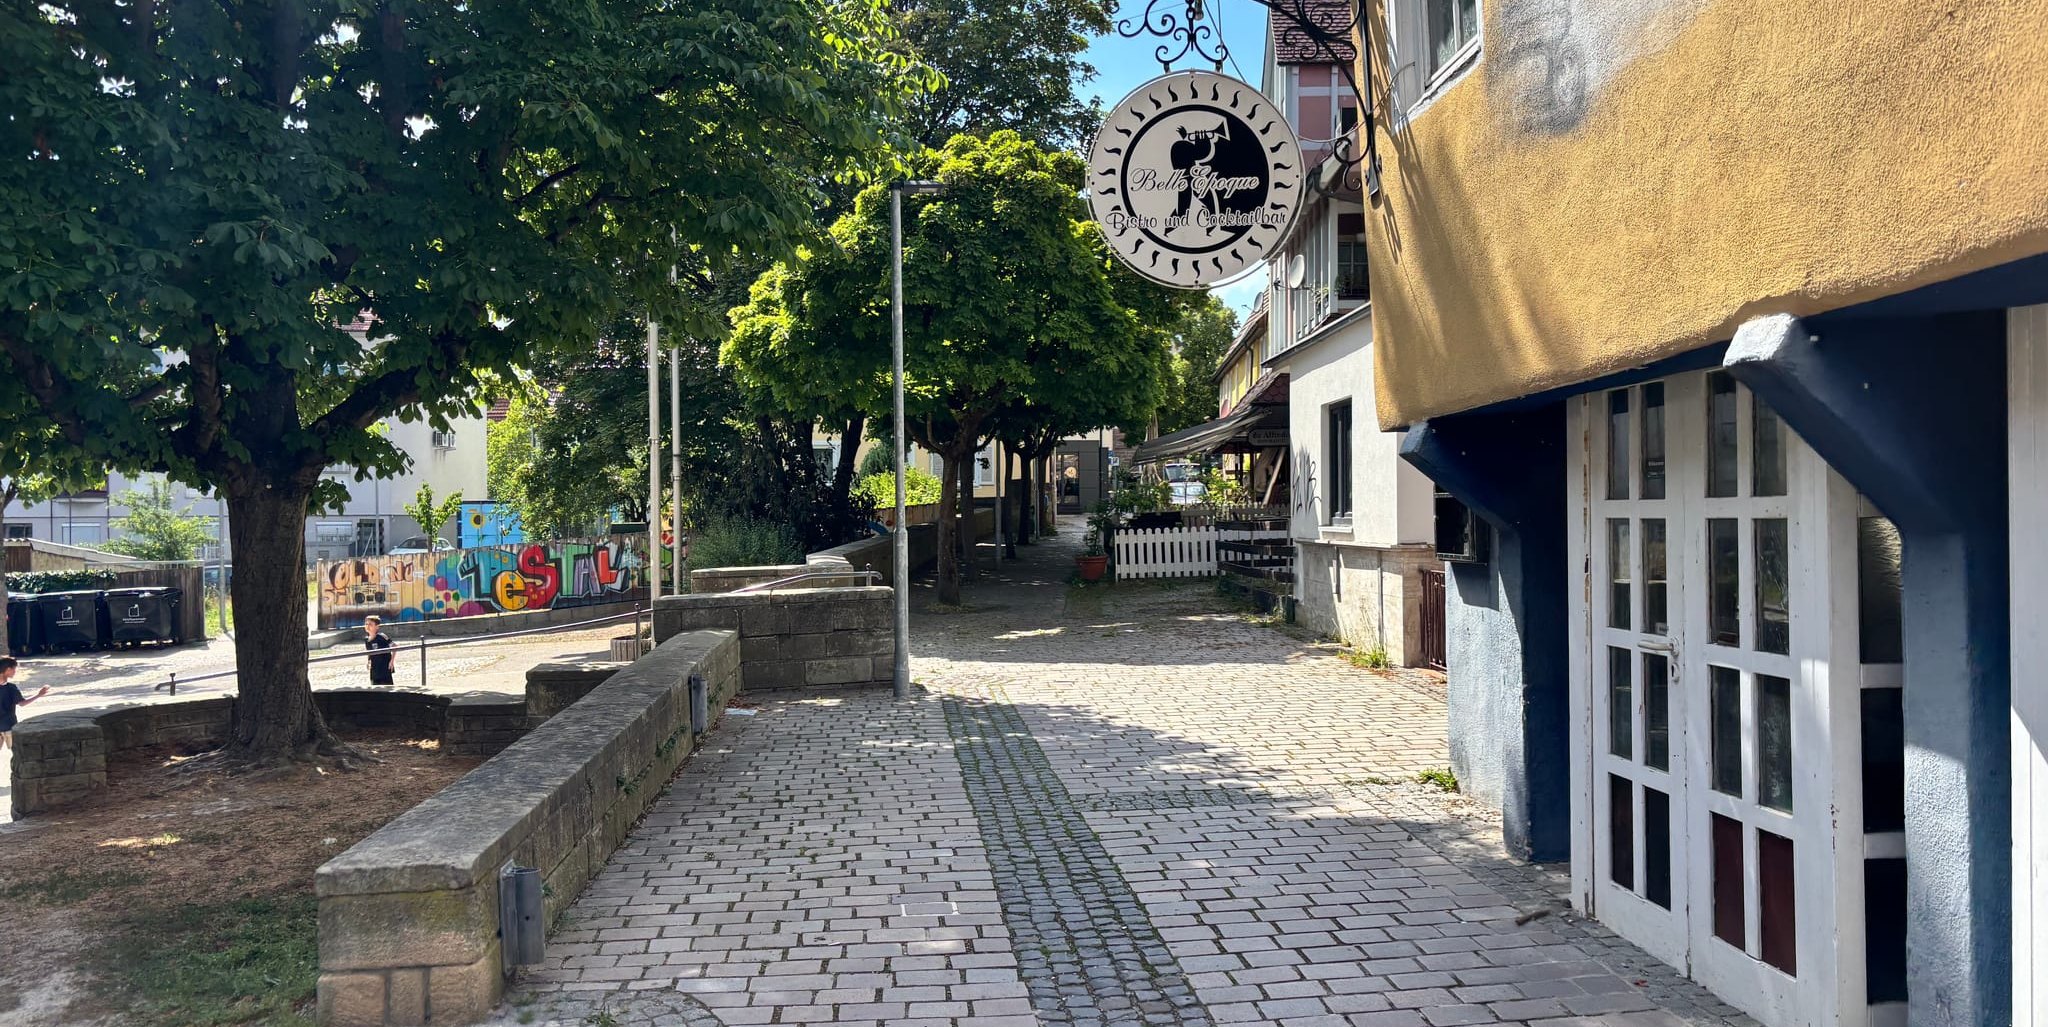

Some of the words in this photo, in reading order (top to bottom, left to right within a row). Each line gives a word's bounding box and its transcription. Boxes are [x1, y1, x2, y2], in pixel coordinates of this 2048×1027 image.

[1131, 167, 1188, 191] Belle
[1190, 165, 1260, 199] Epoque
[1105, 212, 1158, 230] Bistro
[1164, 209, 1190, 227] und
[1197, 207, 1286, 227] Cocktailbar
